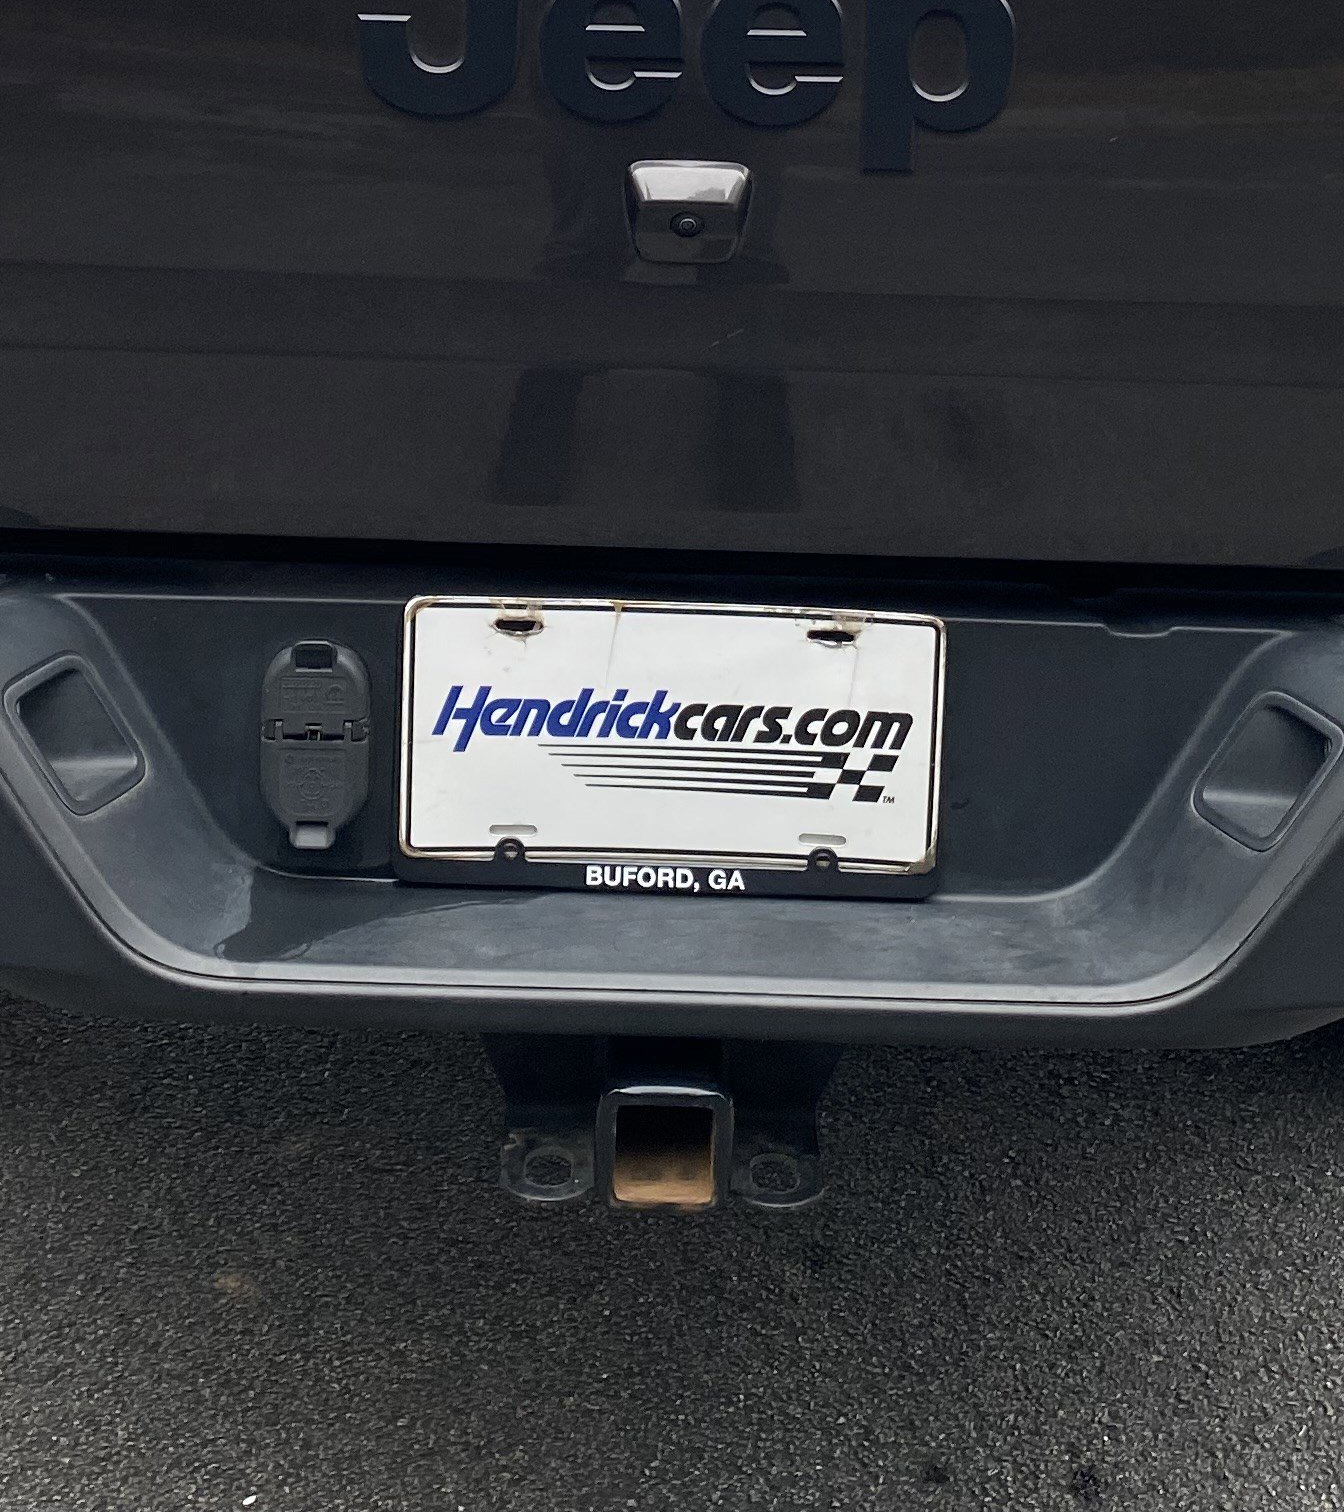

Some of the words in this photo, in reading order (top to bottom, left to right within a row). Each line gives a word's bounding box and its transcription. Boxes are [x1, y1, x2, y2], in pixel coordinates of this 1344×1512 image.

[432, 685, 914, 752] Hendrickcars.com
[585, 866, 702, 893] BUFORD,
[709, 872, 745, 890] GA
